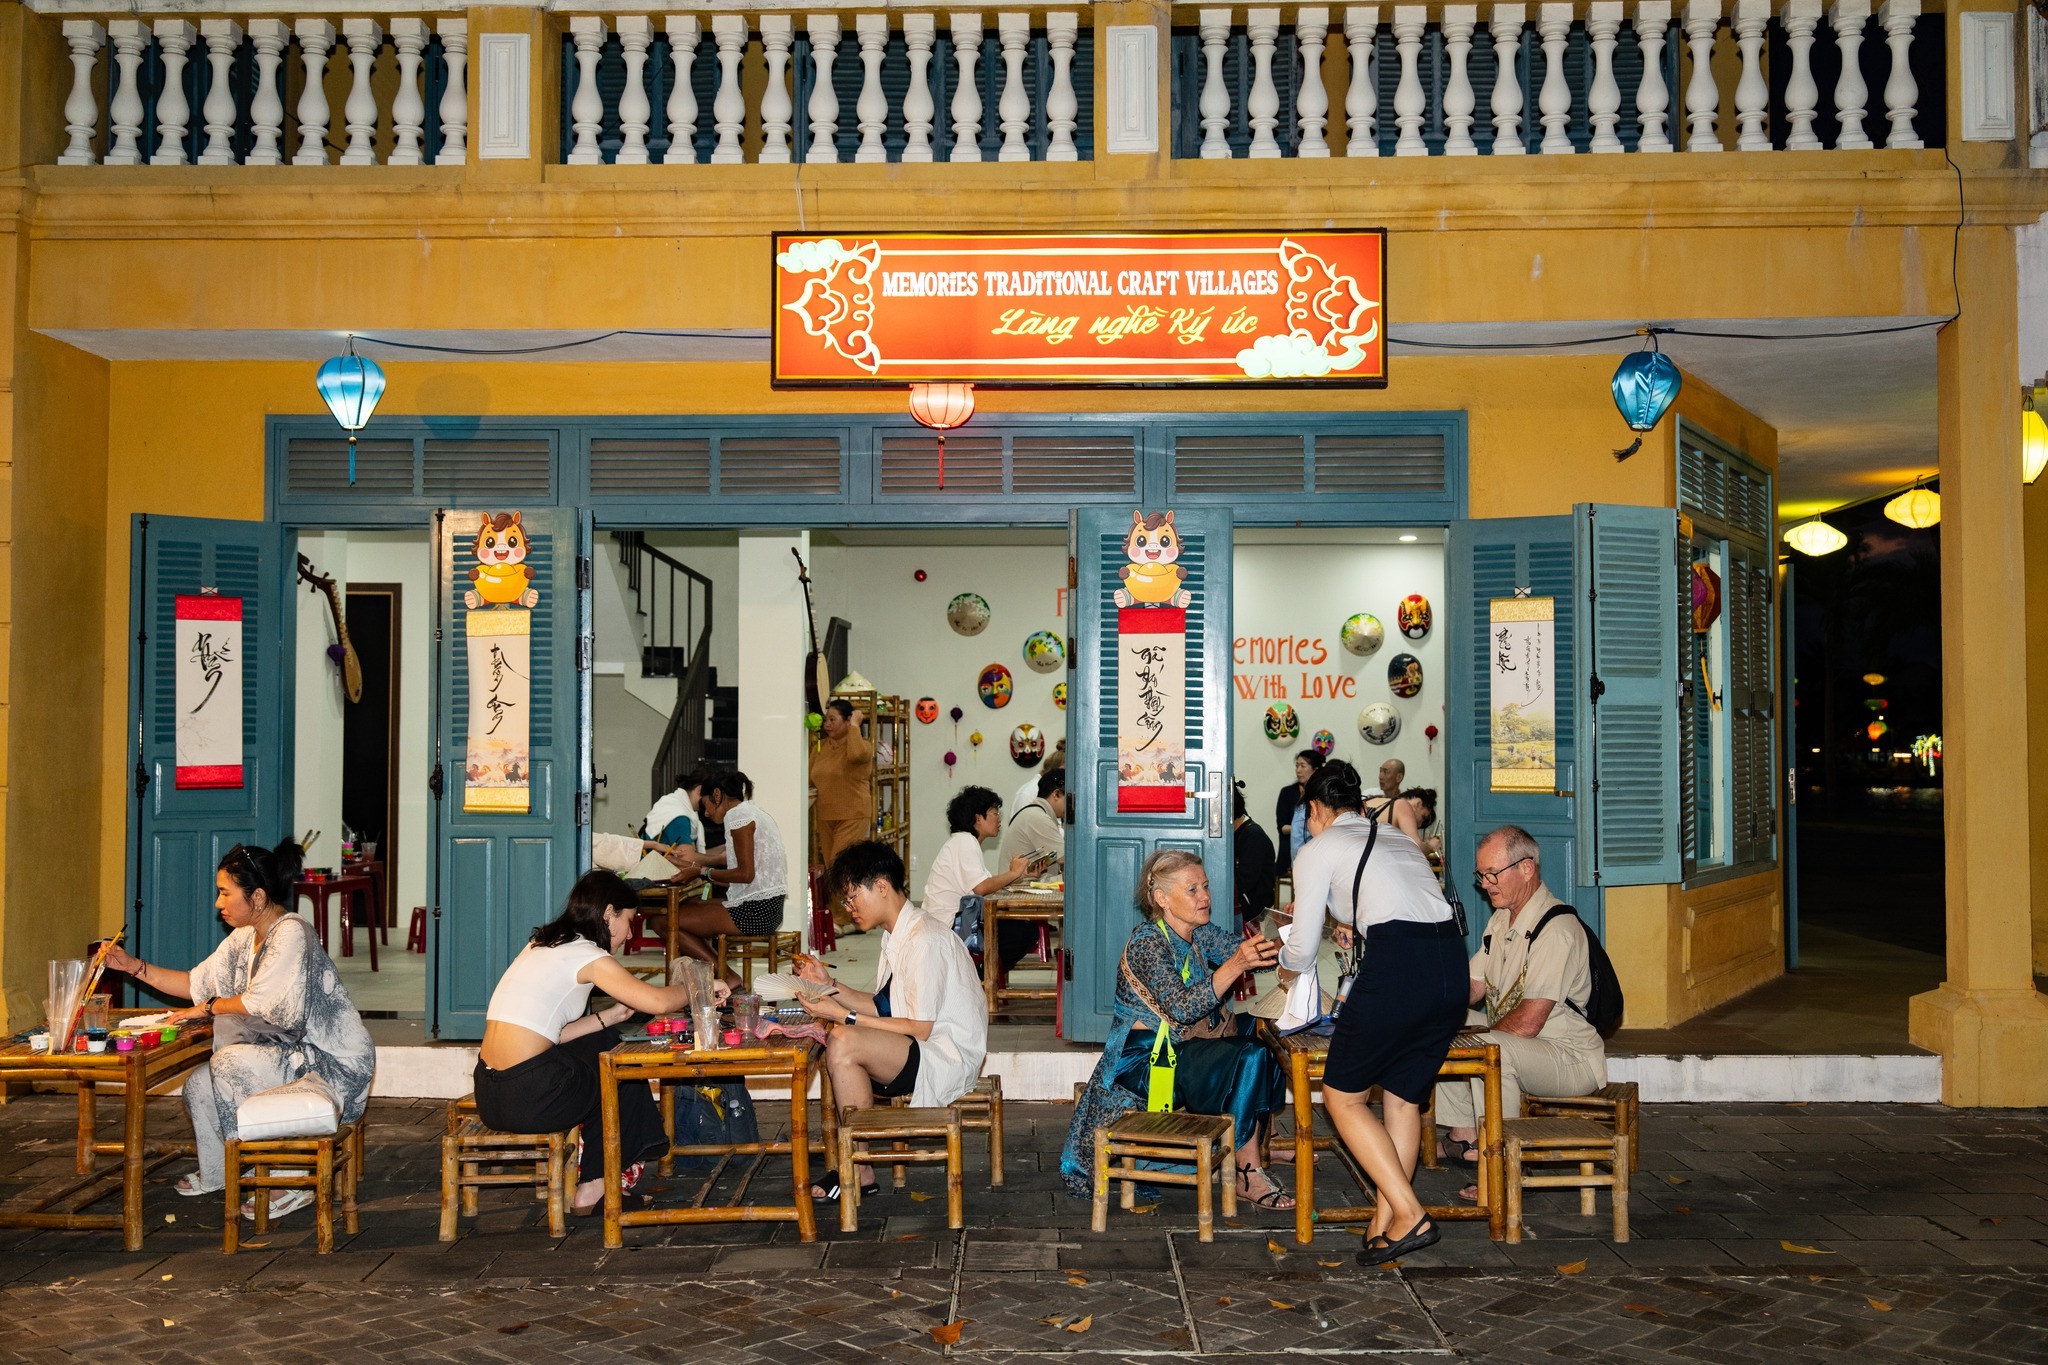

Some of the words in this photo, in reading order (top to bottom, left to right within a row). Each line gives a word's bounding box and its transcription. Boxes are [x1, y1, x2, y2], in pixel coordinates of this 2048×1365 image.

[1117, 270, 1180, 296] CRAFT
[991, 308, 1080, 345] Làng
[1088, 304, 1169, 345] nghề
[1167, 305, 1216, 345] Ký
[1221, 305, 1259, 334] ức
[1233, 634, 1328, 666] emories
[1233, 674, 1288, 700] With
